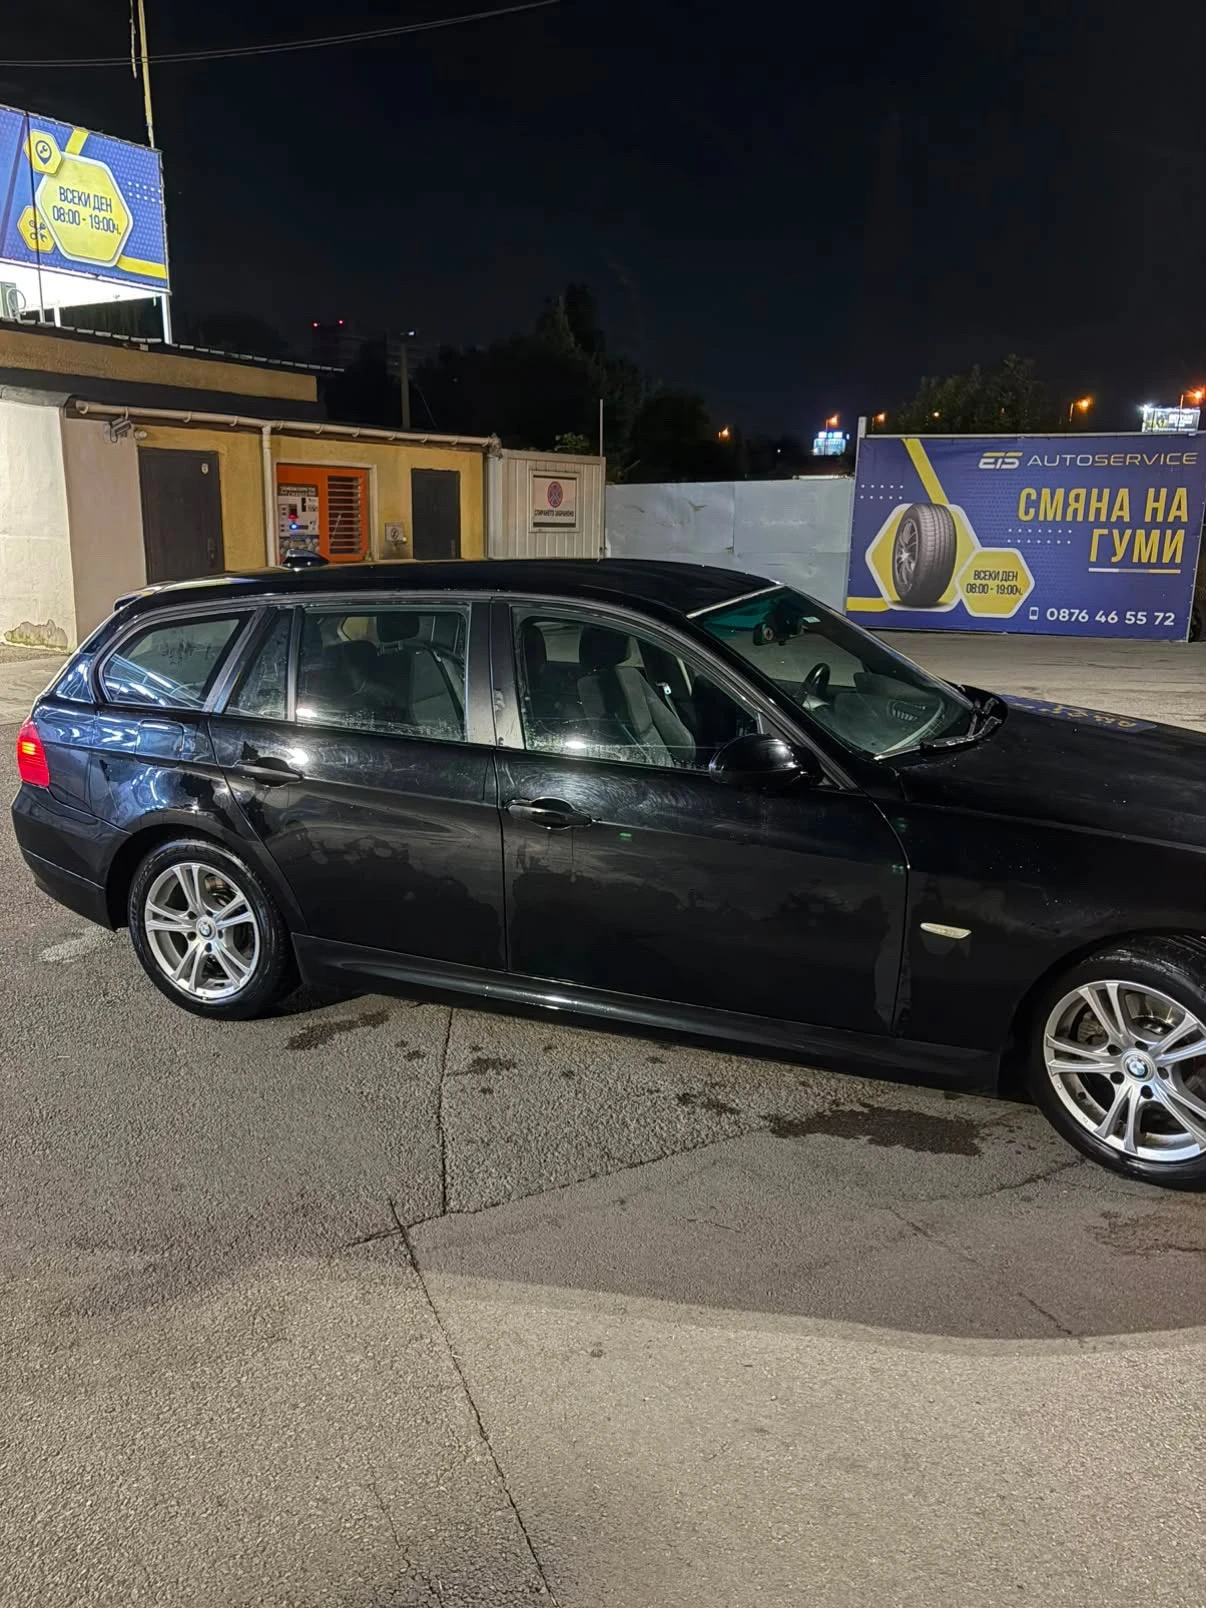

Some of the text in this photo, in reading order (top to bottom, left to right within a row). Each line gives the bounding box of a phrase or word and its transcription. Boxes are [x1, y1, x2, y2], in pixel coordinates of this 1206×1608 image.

[59, 186, 113, 213] ВСЕКИ ДЕН
[52, 205, 81, 226] 08:00
[1027, 452, 1198, 466] AUTOSERVICE
[1018, 487, 1188, 522] СМЯНА НА
[1090, 528, 1185, 563] ГУМИ
[974, 570, 1018, 582] ВСЕКИ ДЕН
[966, 583, 989, 593] 08:00
[1046, 608, 1175, 625] 0876 46 55 72
